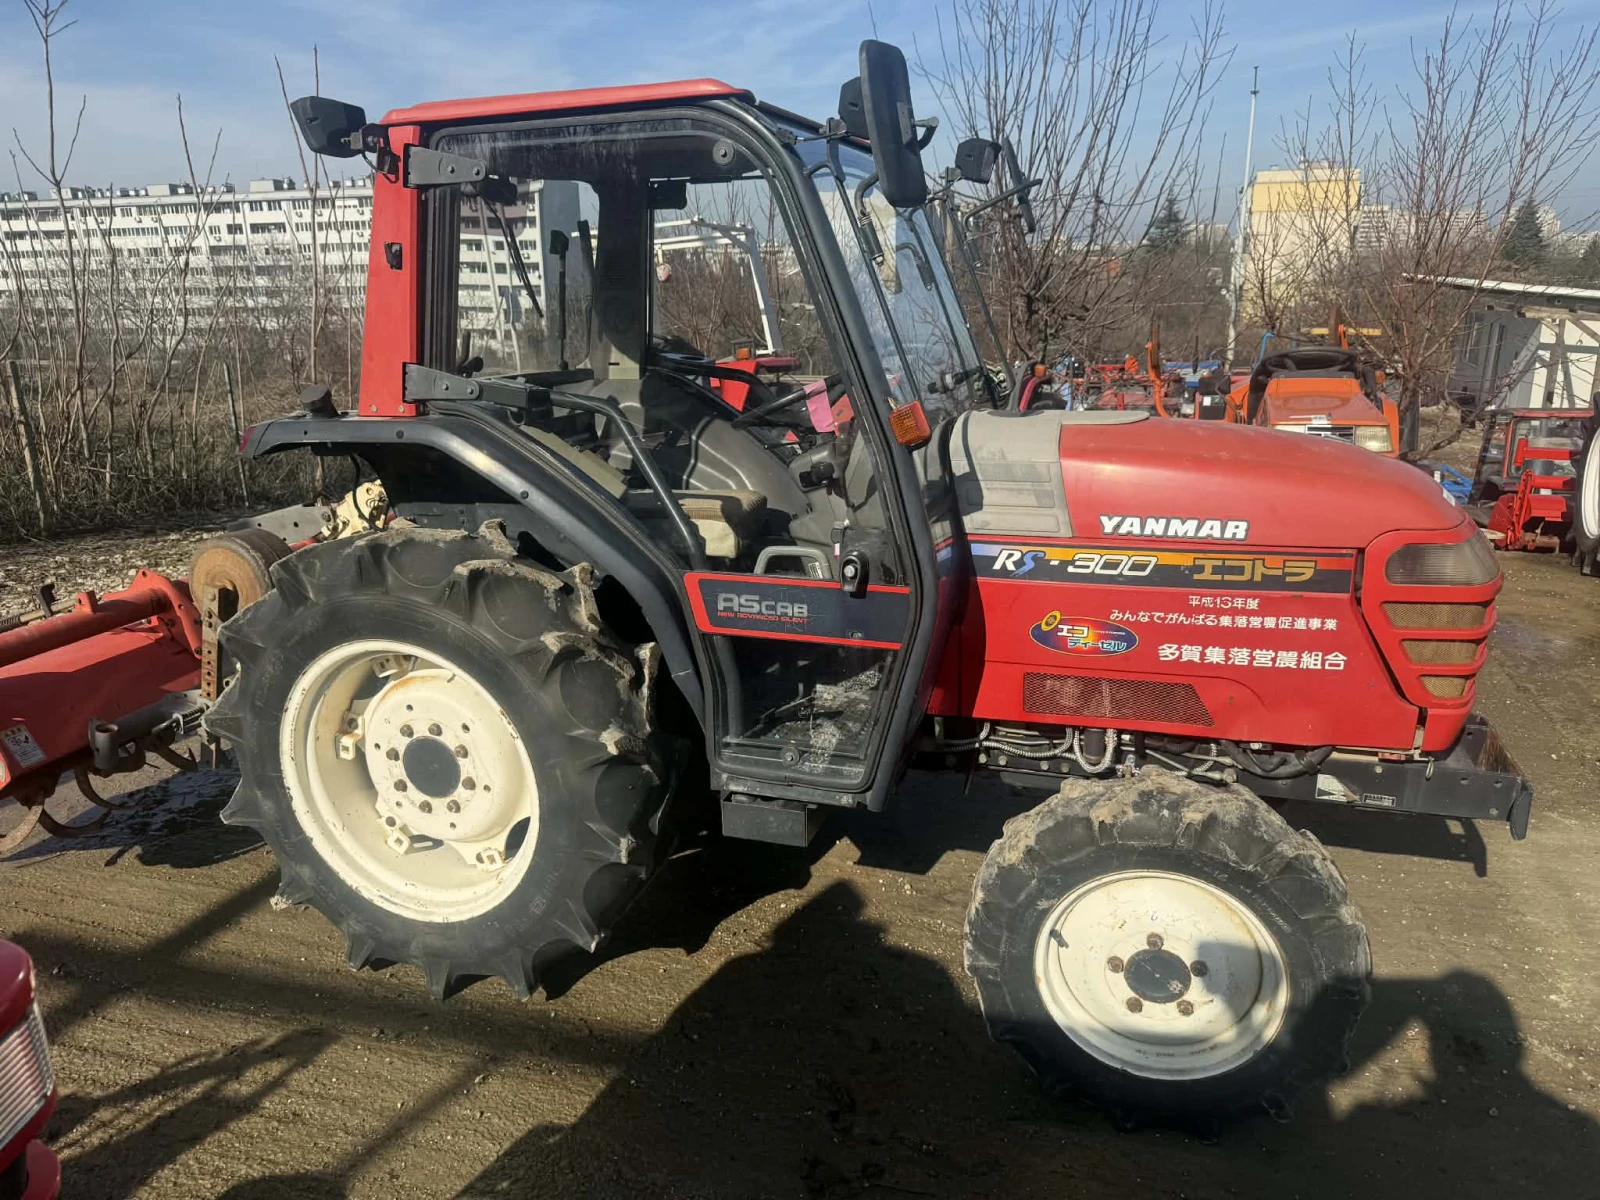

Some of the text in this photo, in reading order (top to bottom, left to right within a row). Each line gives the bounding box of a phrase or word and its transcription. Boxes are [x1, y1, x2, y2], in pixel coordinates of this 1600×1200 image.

[1100, 515, 1249, 540] YANMAR
[1193, 559, 1316, 582] エコトラ
[1056, 624, 1090, 638] エコ
[1109, 609, 1338, 631] みんなでがんばる集落営農促進事業
[1067, 637, 1127, 652] ディーゼル
[1157, 643, 1348, 671] 多賀集落営農組合
